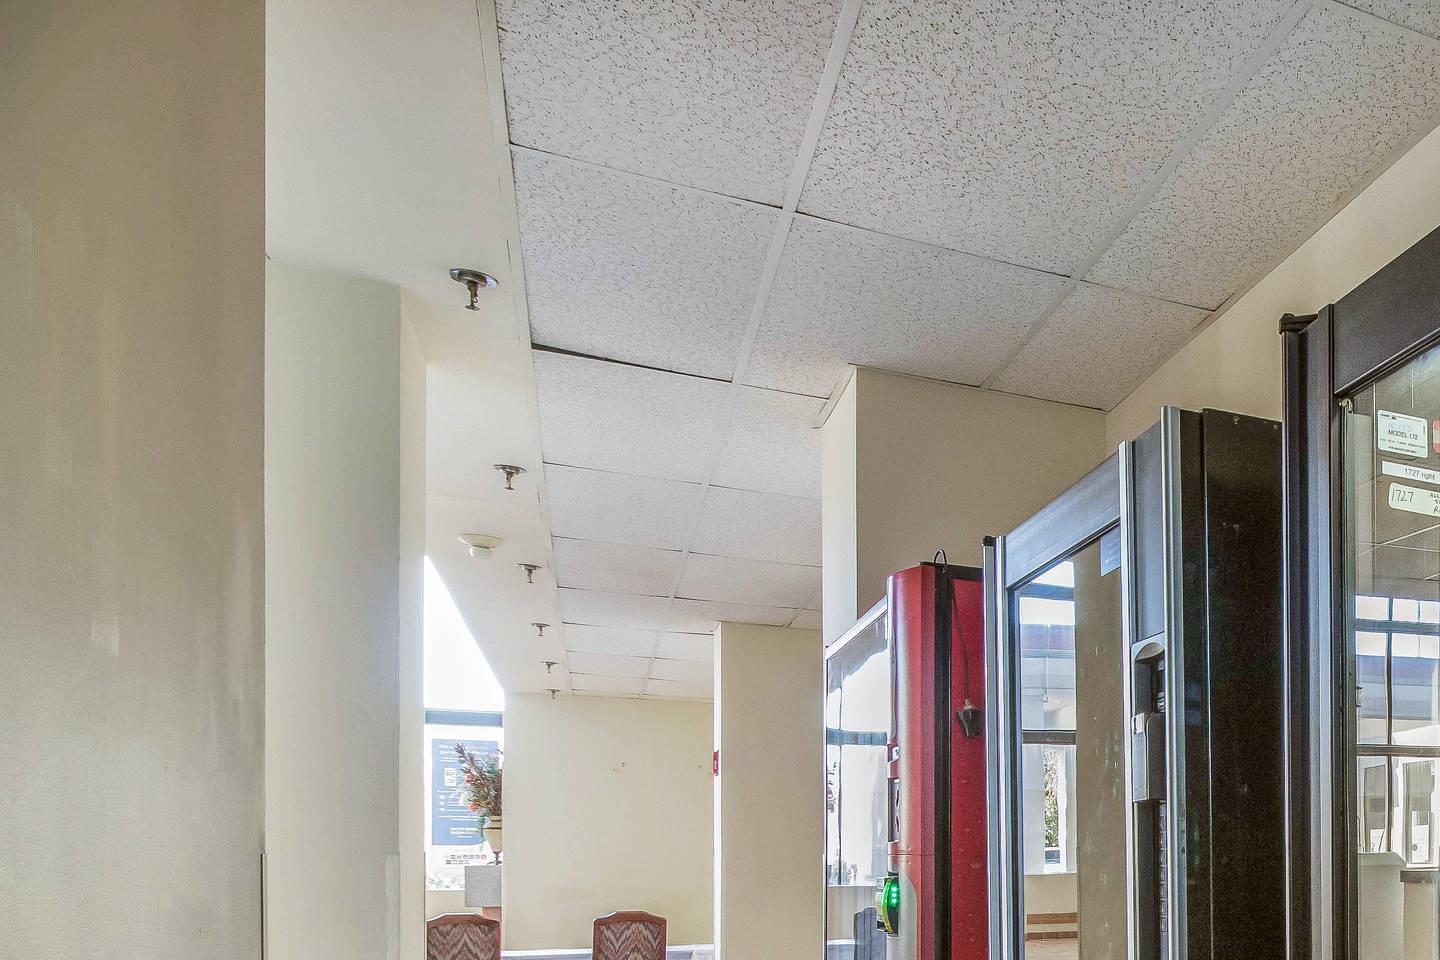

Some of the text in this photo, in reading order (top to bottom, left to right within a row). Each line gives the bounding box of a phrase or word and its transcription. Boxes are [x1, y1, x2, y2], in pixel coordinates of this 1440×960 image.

[1388, 429, 1408, 439] MODEL
[1405, 468, 1420, 479] 1727
[1391, 489, 1414, 502] 1727
